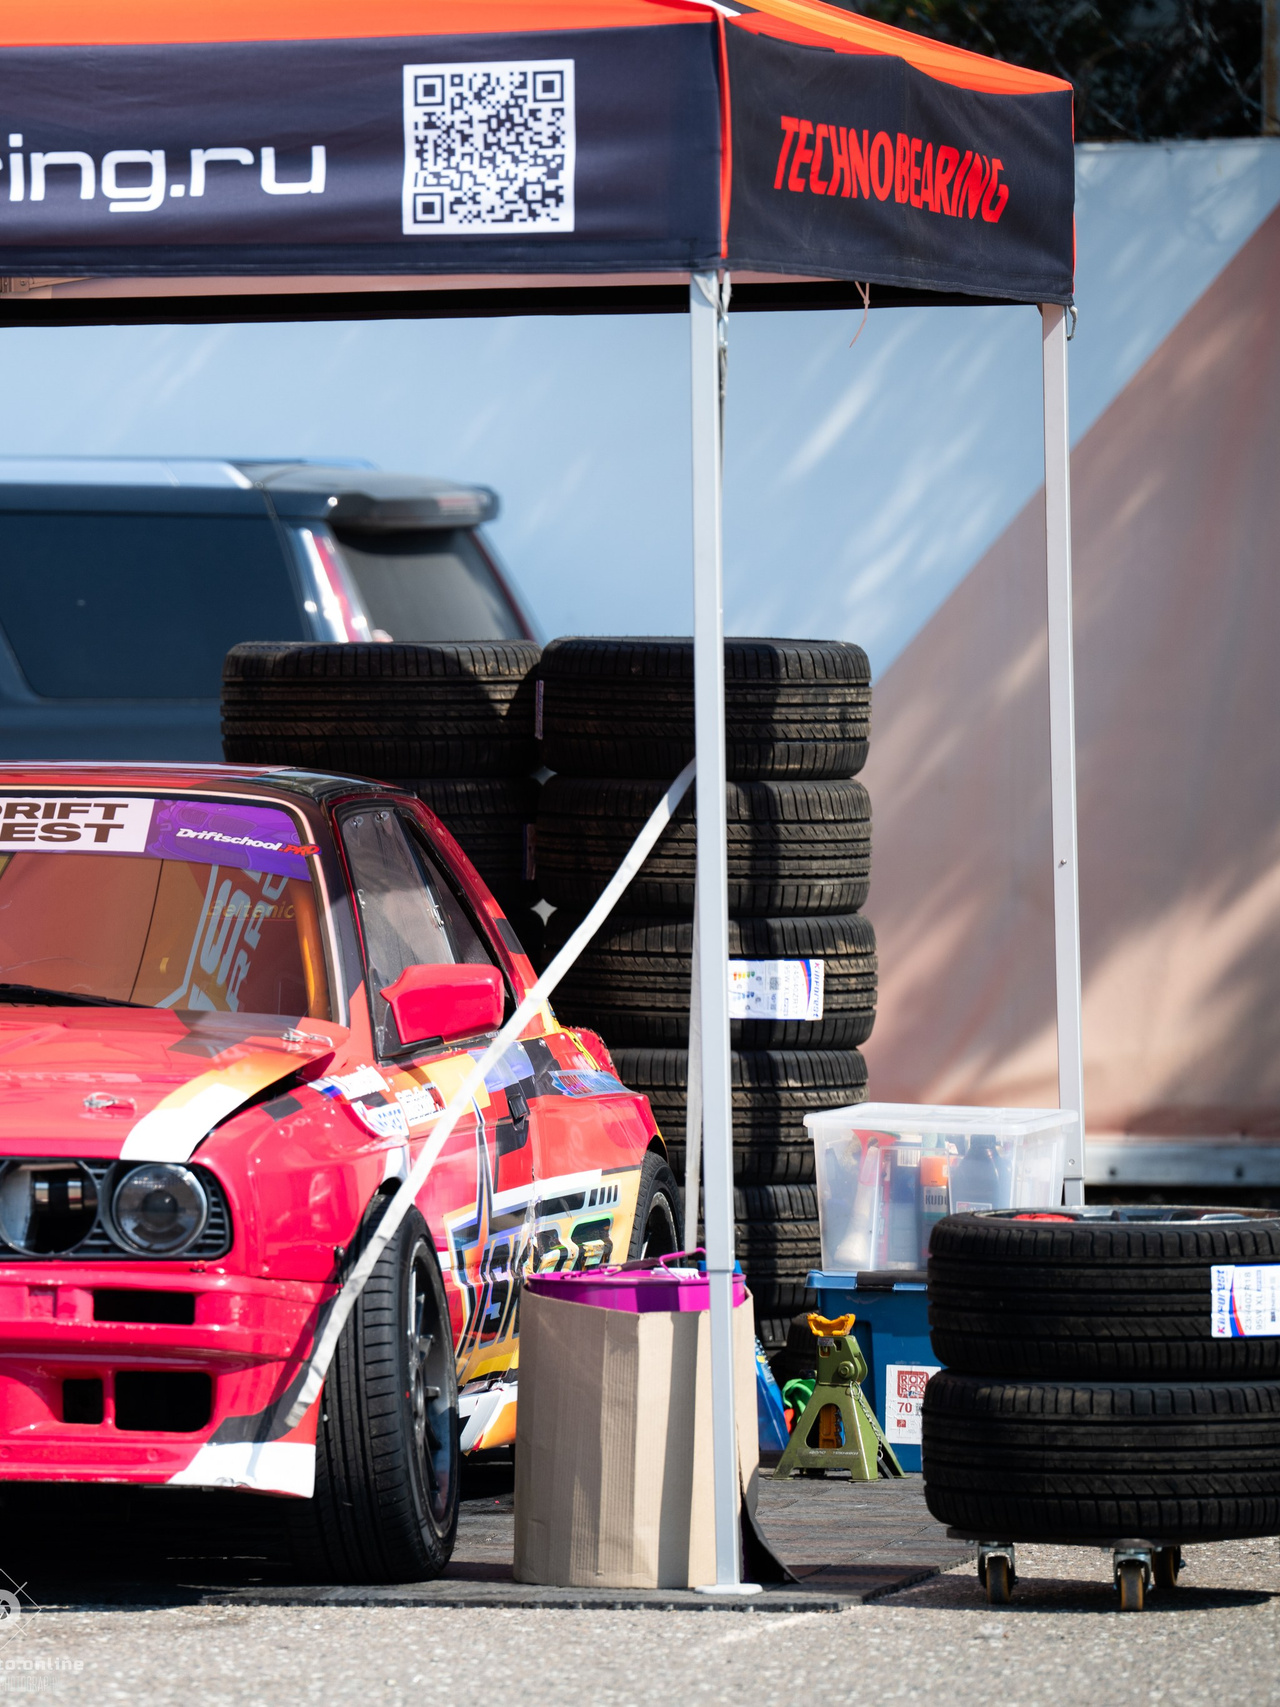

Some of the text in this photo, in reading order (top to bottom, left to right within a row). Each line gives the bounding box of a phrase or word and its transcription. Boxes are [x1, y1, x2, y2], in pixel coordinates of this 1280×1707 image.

[773, 115, 1010, 225] TECHNOBEARING
[176, 827, 320, 857] Driftschool.PRO
[897, 1401, 913, 1414] 70
